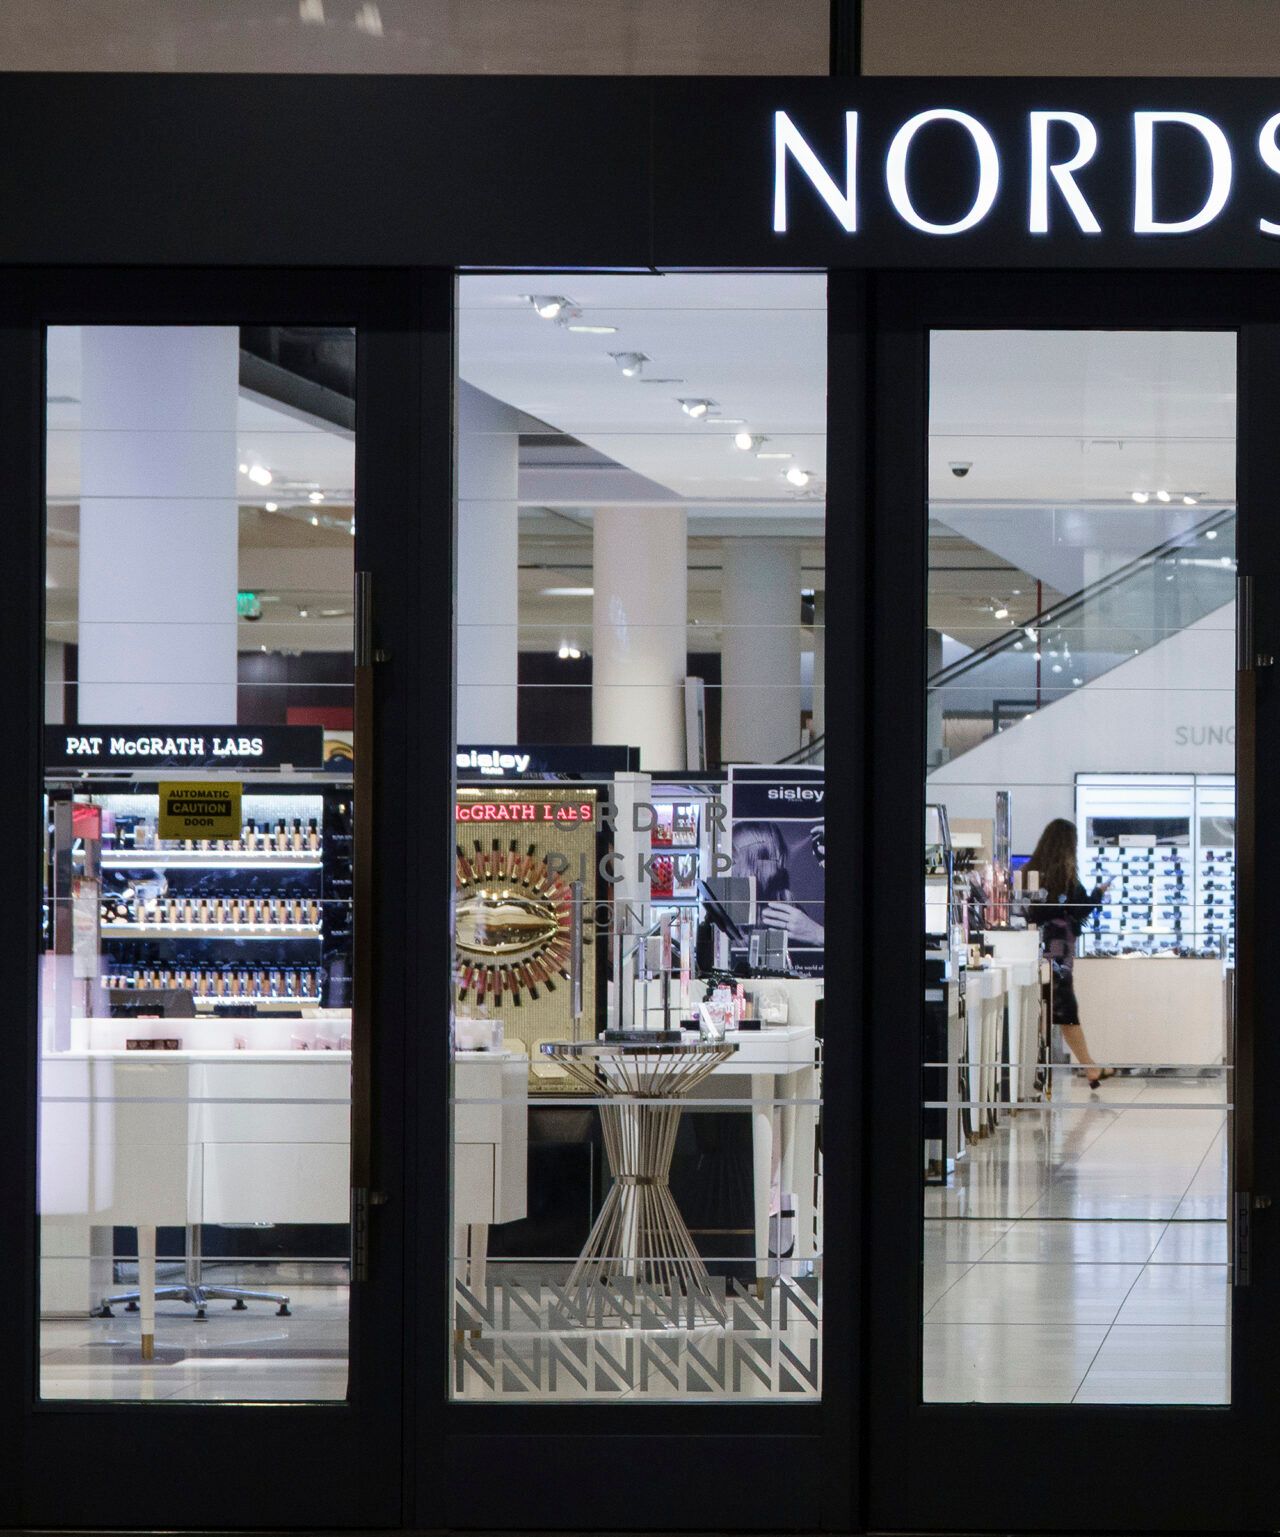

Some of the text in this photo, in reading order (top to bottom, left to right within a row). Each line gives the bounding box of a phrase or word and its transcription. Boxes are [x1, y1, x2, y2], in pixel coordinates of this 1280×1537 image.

[66, 737, 264, 755] PAT McGRATH LABS
[456, 750, 530, 772] sisley
[169, 789, 230, 798] AUTOMATIC
[767, 786, 825, 803] sisley
[172, 802, 227, 814] CAUTION
[553, 801, 728, 833] ORDER
[184, 818, 215, 827] DOOR
[547, 852, 733, 884] PICKUP
[594, 903, 645, 928] ON
